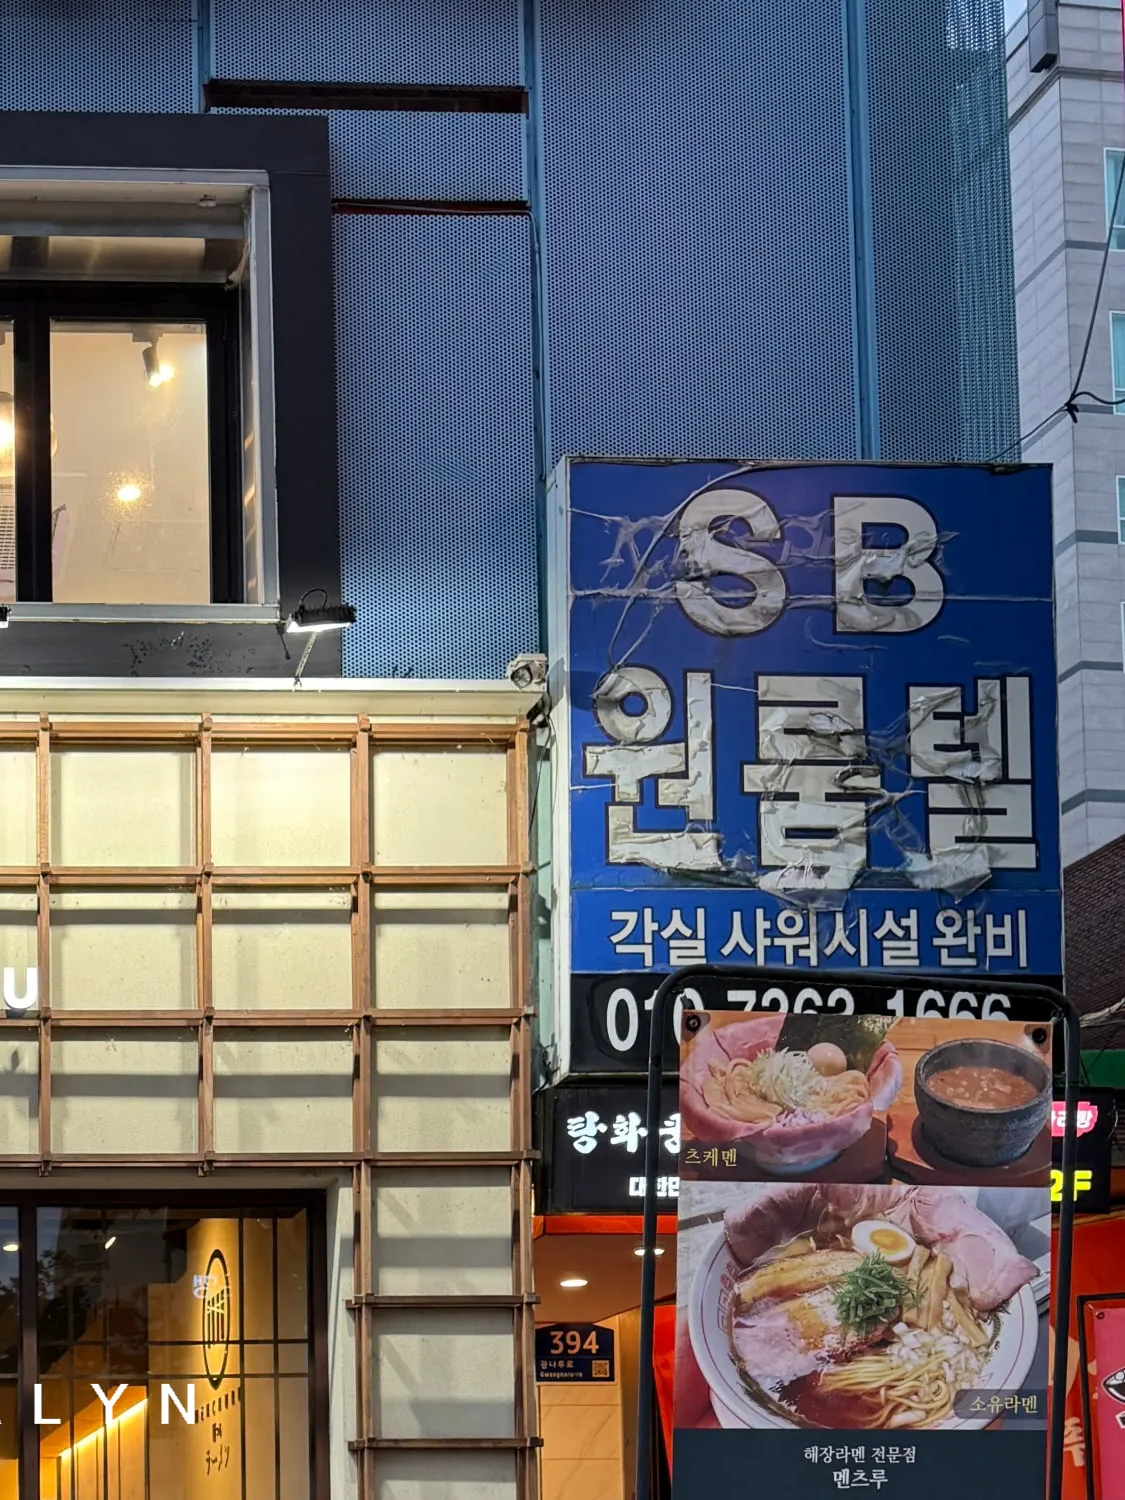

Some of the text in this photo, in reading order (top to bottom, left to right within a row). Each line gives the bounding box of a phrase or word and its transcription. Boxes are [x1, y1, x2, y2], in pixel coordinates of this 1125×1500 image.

[676, 488, 945, 637] SB
[582, 664, 1038, 870] 원룸텔
[609, 908, 1028, 969] 각실 샤워시설 완비
[684, 1147, 737, 1167] 츠케멘
[550, 1330, 599, 1354] 394
[969, 1394, 1038, 1414] 소유라멘
[804, 1446, 916, 1463] 해장라멘 전문점
[833, 1468, 888, 1489] 멘츠루
